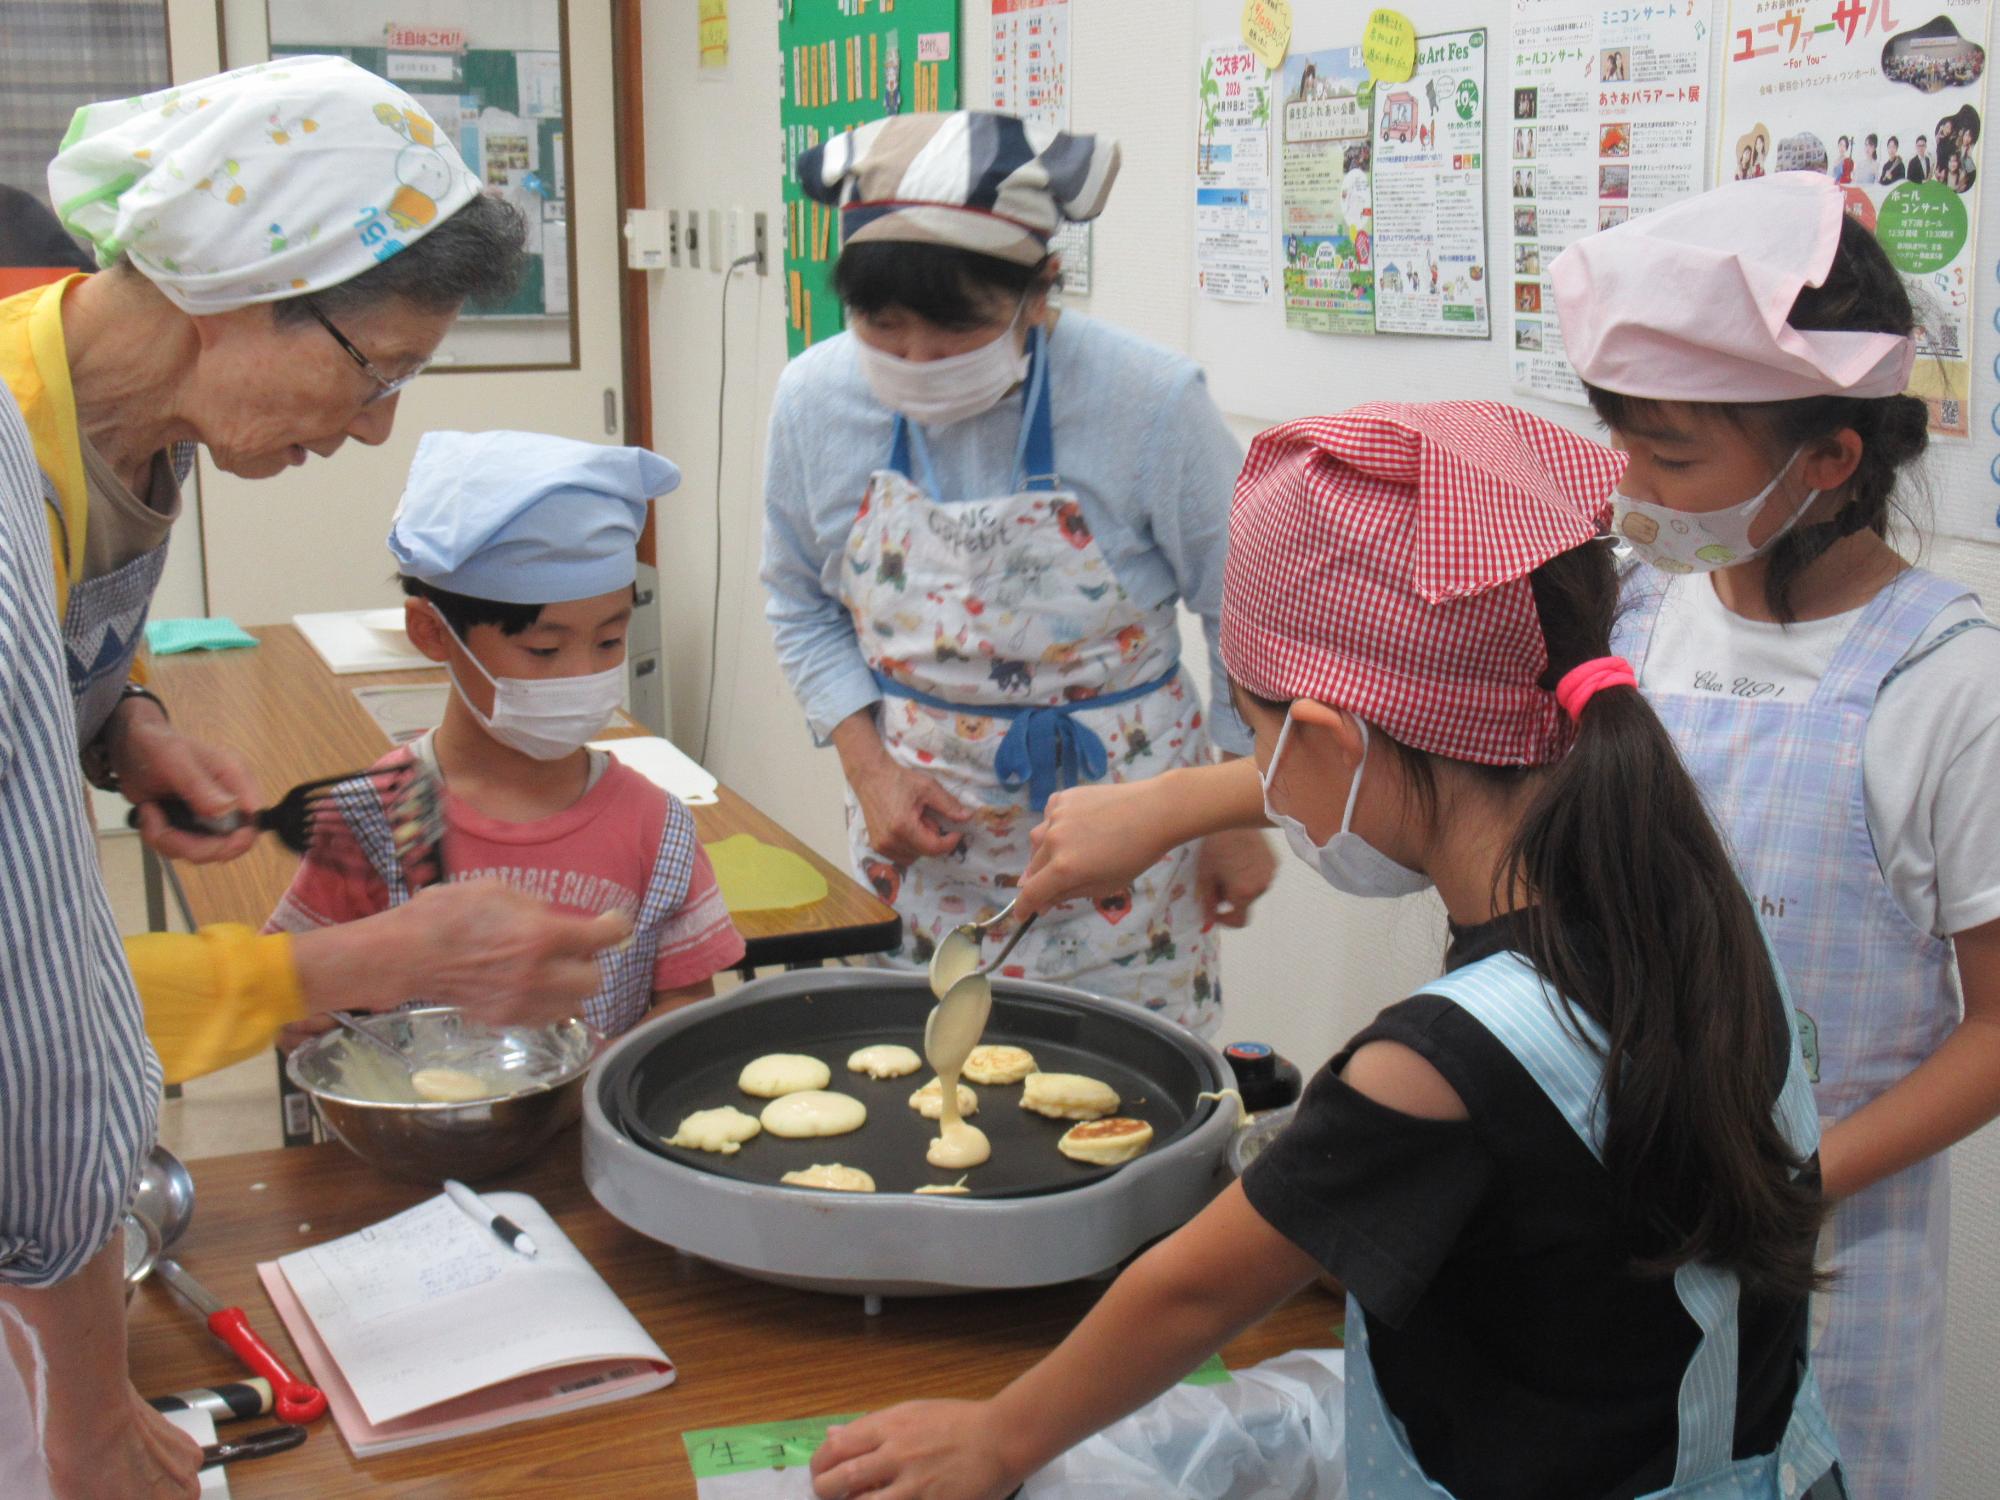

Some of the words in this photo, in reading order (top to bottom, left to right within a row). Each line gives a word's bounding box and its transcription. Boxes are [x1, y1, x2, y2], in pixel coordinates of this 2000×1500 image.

[1602, 4, 1677, 24] ミニコンサート
[391, 31, 461, 46] 注目はこれ!!
[1733, 0, 1900, 62] ユニヴァーサル
[1427, 46, 1445, 64] Art
[1448, 42, 1469, 61] Fes
[1515, 47, 1583, 66] ホールコンサート
[1215, 53, 1255, 76] こ文まつり
[1599, 85, 1700, 106] あさおパラアート展
[1891, 190, 1921, 202] ホール
[1901, 202, 1950, 214] コンサート
